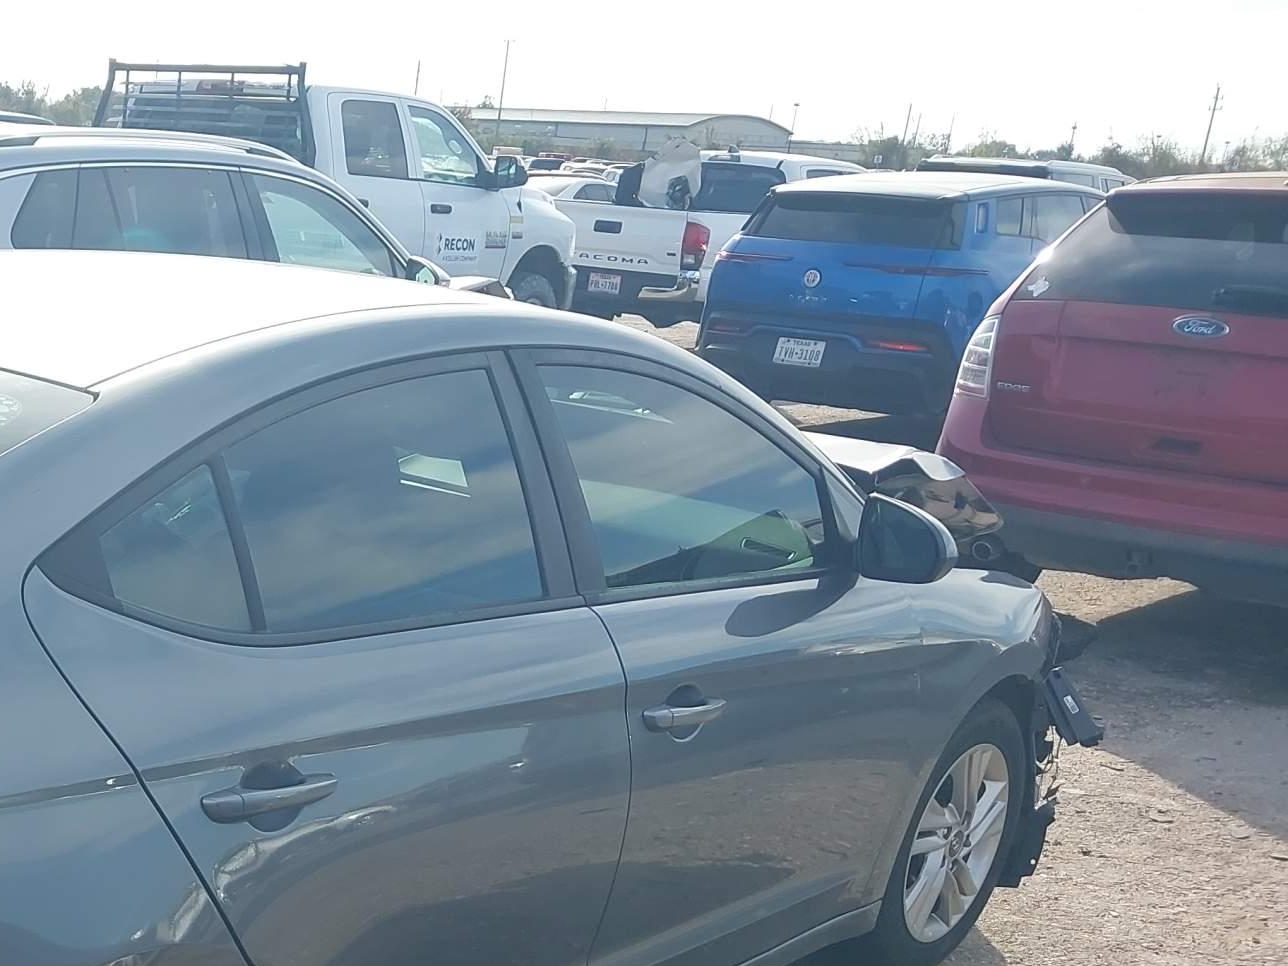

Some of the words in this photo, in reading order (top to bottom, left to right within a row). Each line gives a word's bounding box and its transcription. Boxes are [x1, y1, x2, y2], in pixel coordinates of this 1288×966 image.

[444, 238, 475, 251] RECON
[574, 251, 649, 265] ACOMA
[1184, 319, 1217, 334] Ford
